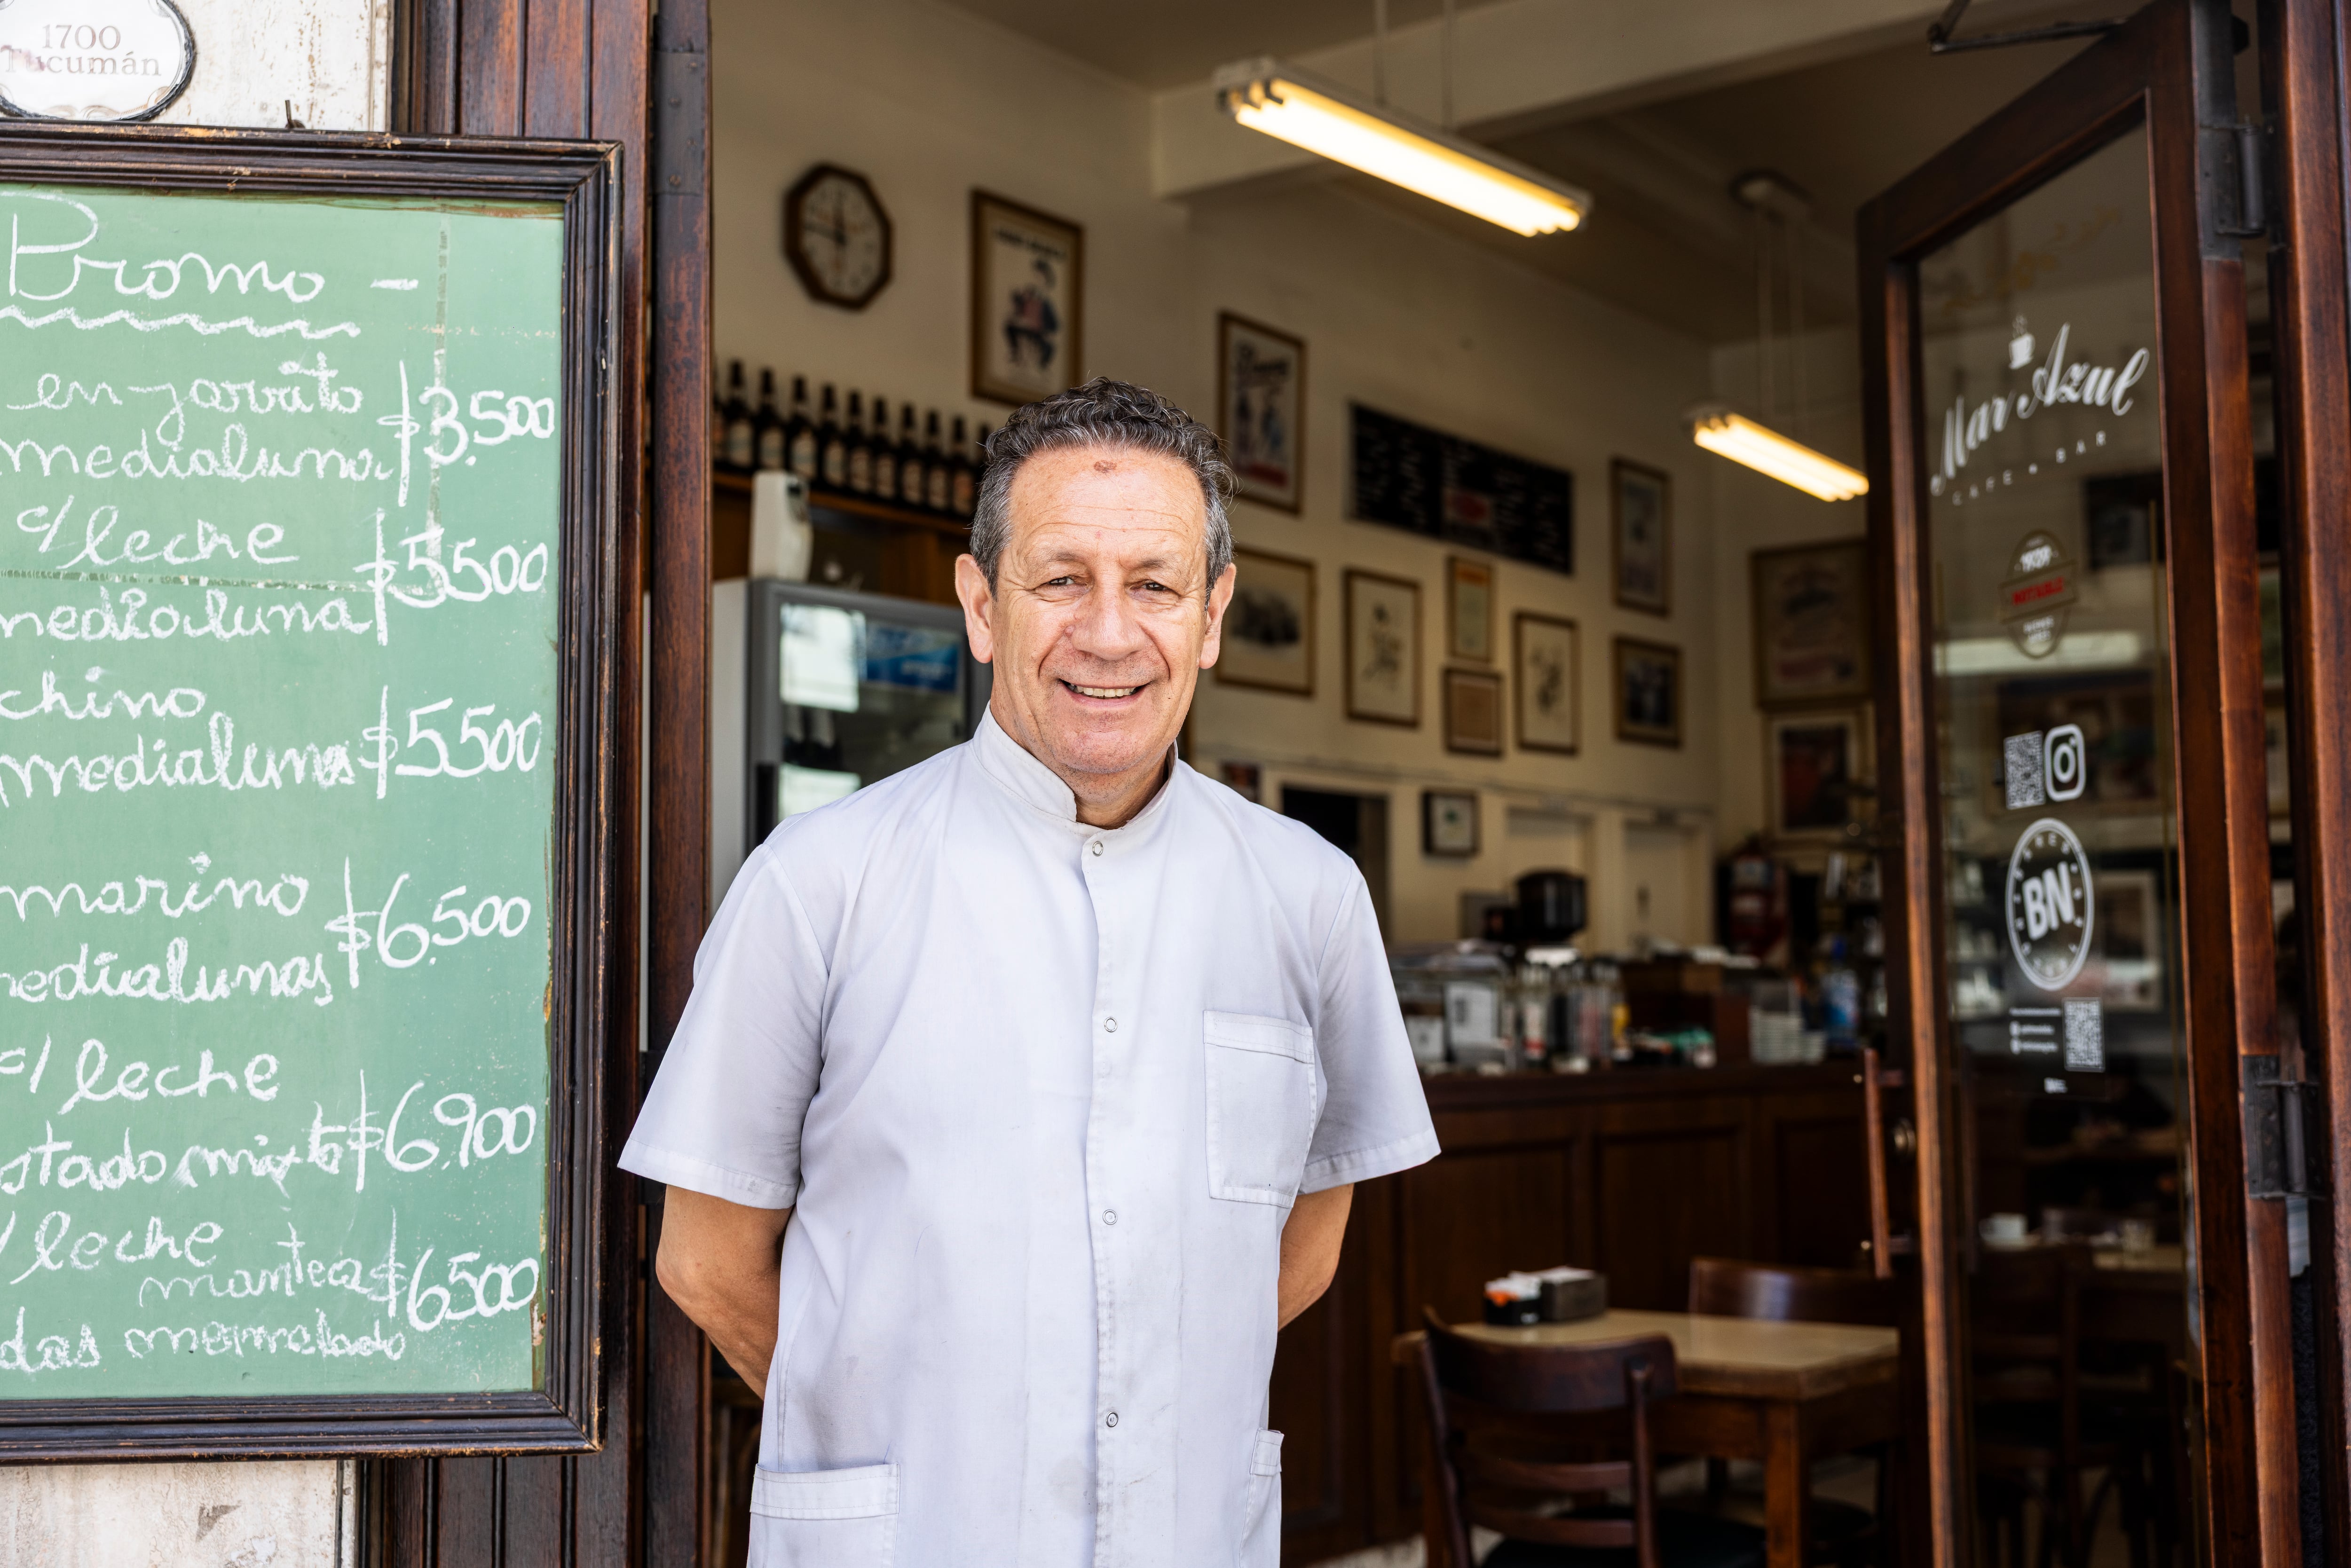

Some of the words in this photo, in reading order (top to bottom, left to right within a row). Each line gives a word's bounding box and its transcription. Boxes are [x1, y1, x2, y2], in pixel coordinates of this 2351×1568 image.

[2, 47, 162, 77] Tucumán
[42, 24, 122, 50] 1700
[1, 191, 325, 303] Promo
[1930, 390, 2016, 496] Mar
[2017, 322, 2150, 418] Azul
[2022, 860, 2075, 941] BN
